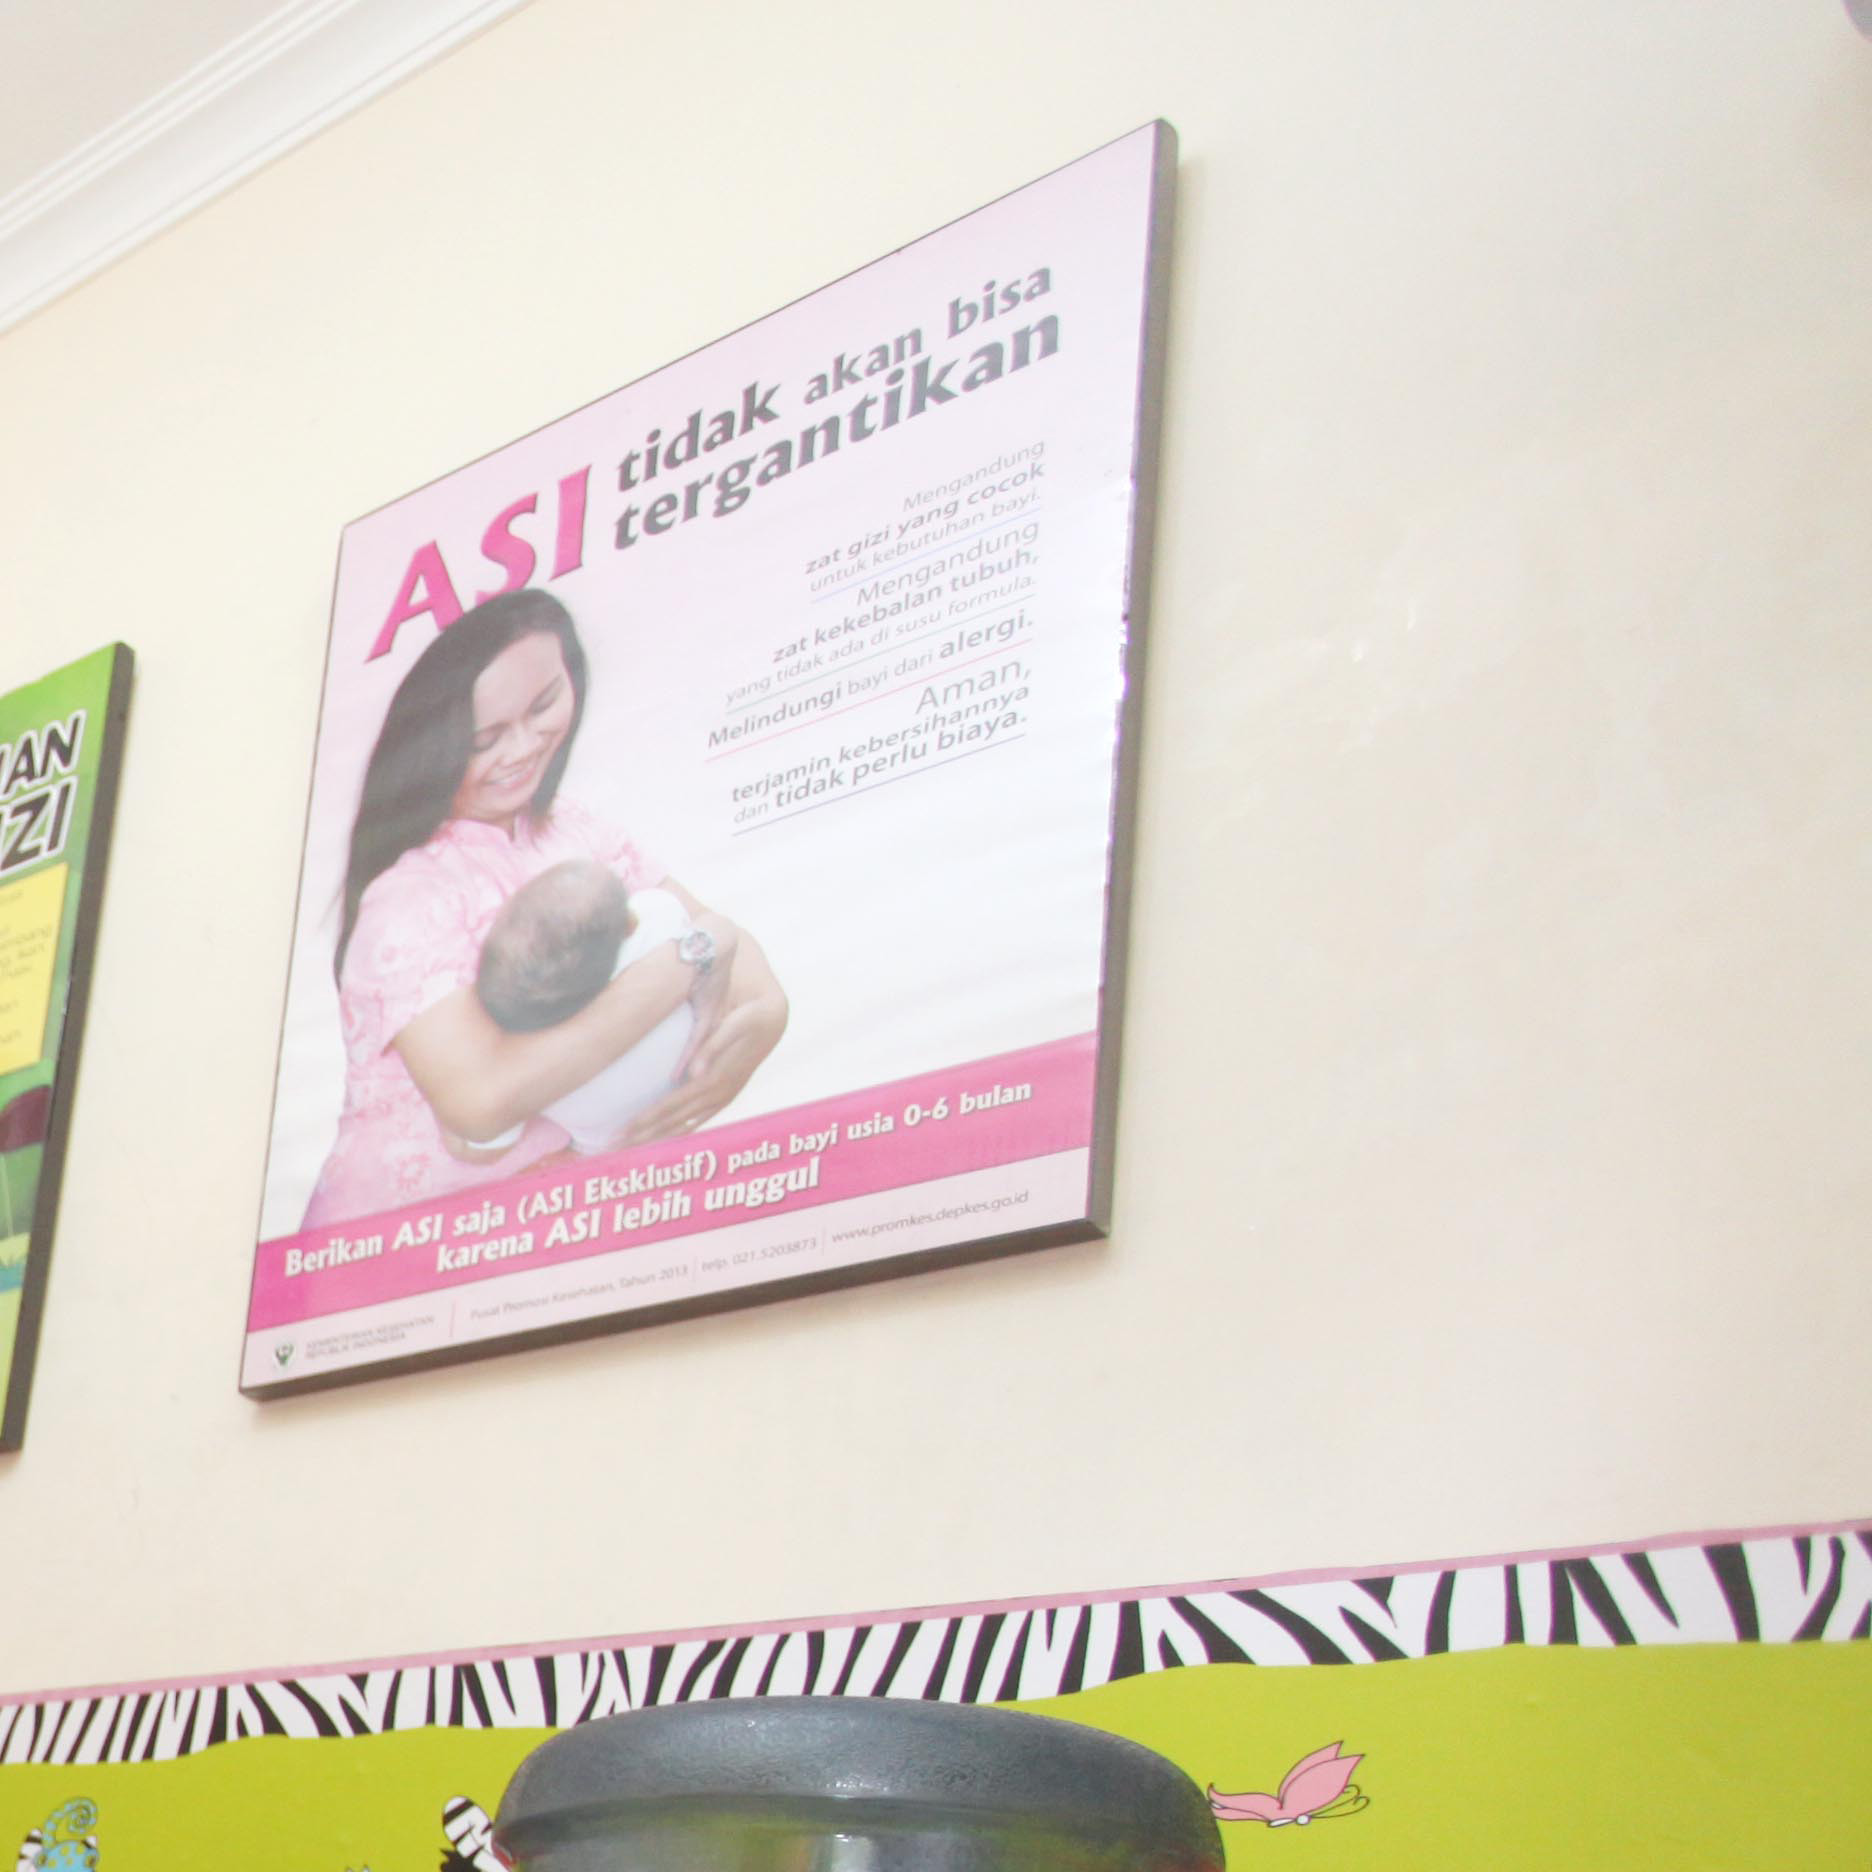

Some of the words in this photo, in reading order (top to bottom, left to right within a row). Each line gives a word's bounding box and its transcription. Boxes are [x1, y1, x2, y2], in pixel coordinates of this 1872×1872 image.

[615, 314, 1061, 551] tergantikan
[616, 381, 781, 491] tidak
[805, 329, 922, 406] akan
[948, 266, 1052, 339] bisa
[805, 548, 841, 575] zat
[848, 525, 889, 560] gizi
[897, 498, 960, 540] yang
[967, 462, 1045, 507] cocok
[904, 441, 1045, 512] Mengandung
[365, 464, 592, 664] ASI
[773, 637, 808, 663] zat
[814, 583, 943, 645] kekebalan
[951, 548, 1040, 594] tubuh,
[810, 560, 865, 593] untuk
[872, 512, 985, 567] kebutuhan
[856, 521, 1039, 606] Mengandung
[708, 682, 841, 748] Melindungi
[848, 666, 889, 696] bayi
[895, 649, 934, 676] dari
[939, 609, 1034, 660] alergi.
[726, 676, 772, 706] yang
[776, 655, 824, 684] tidak
[829, 638, 864, 663] ada
[870, 626, 889, 646] di
[895, 613, 942, 636] susu
[947, 576, 1037, 616] formula.
[916, 659, 1032, 714] Aman,
[732, 755, 831, 802] terjamin
[839, 687, 1030, 763] kebersihannya
[734, 802, 769, 824] dan
[776, 768, 844, 808] tidak
[852, 742, 928, 786] perlu
[937, 711, 1028, 752] biaya.
[285, 1233, 383, 1277] Berikan
[392, 1213, 444, 1250] ASI
[453, 1201, 506, 1236] saja
[517, 1184, 573, 1224] (ASI
[584, 1150, 717, 1206] Eksklusif)
[728, 1140, 780, 1174] pada
[789, 1123, 838, 1157] bayi
[847, 1112, 894, 1141] usia
[904, 1096, 950, 1127] 0-6
[959, 1081, 1032, 1116] bulan
[436, 1231, 534, 1273] karena
[545, 1206, 602, 1249] ASI
[613, 1193, 691, 1232] lebih
[704, 1156, 820, 1208] unggul
[831, 1189, 1031, 1246] www.promkes.depkes.go.id
